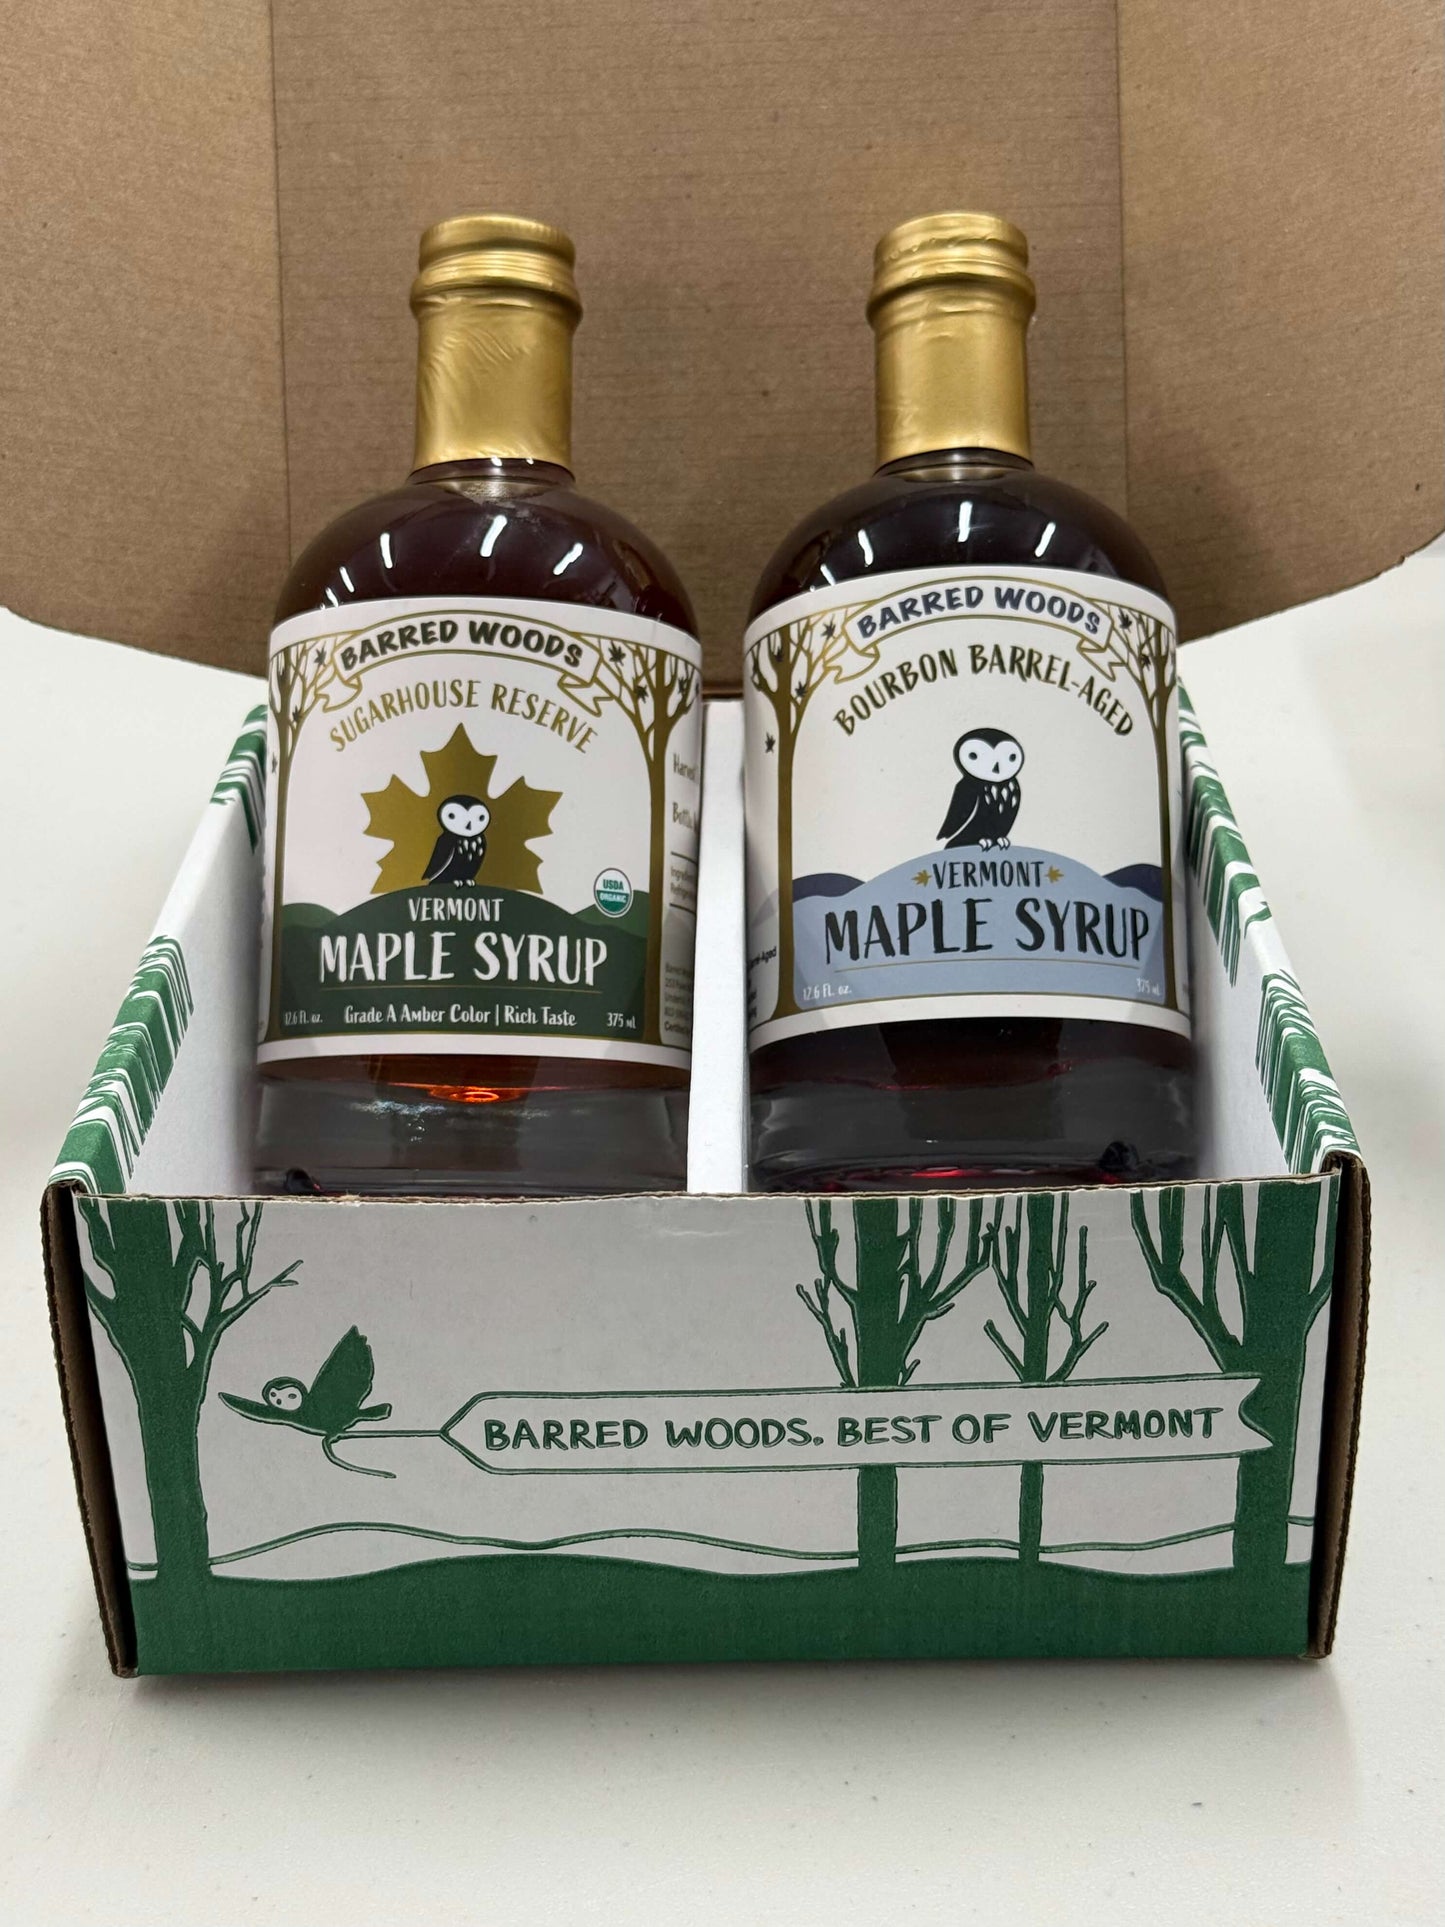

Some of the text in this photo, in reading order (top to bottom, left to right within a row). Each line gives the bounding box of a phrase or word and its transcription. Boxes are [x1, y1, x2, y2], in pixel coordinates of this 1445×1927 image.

[856, 585, 1101, 639] BARRED WOODS
[340, 620, 584, 672] BARRED WOODS
[832, 643, 1134, 737] BOURBON BARREL-AGED
[329, 678, 598, 754] SUGARHOUSE RESERVE
[602, 879, 625, 891] USDA
[931, 859, 1045, 890] VERMONT
[408, 897, 504, 923] VERMONT
[825, 897, 1150, 965] MAPLE SYRUP
[319, 930, 608, 987] MAPLE SYRUP
[838, 984, 853, 996] oz.
[311, 1013, 323, 1024] oz.
[344, 1004, 384, 1024] Grade
[386, 1003, 398, 1022] A
[400, 1003, 446, 1023] Amber
[450, 1003, 491, 1024] Color
[504, 1004, 539, 1025] Rich
[541, 1006, 578, 1027] Taste
[606, 1012, 625, 1028] 375
[483, 1406, 1224, 1451] BARRED WOODS. BEST OF VERMONT
